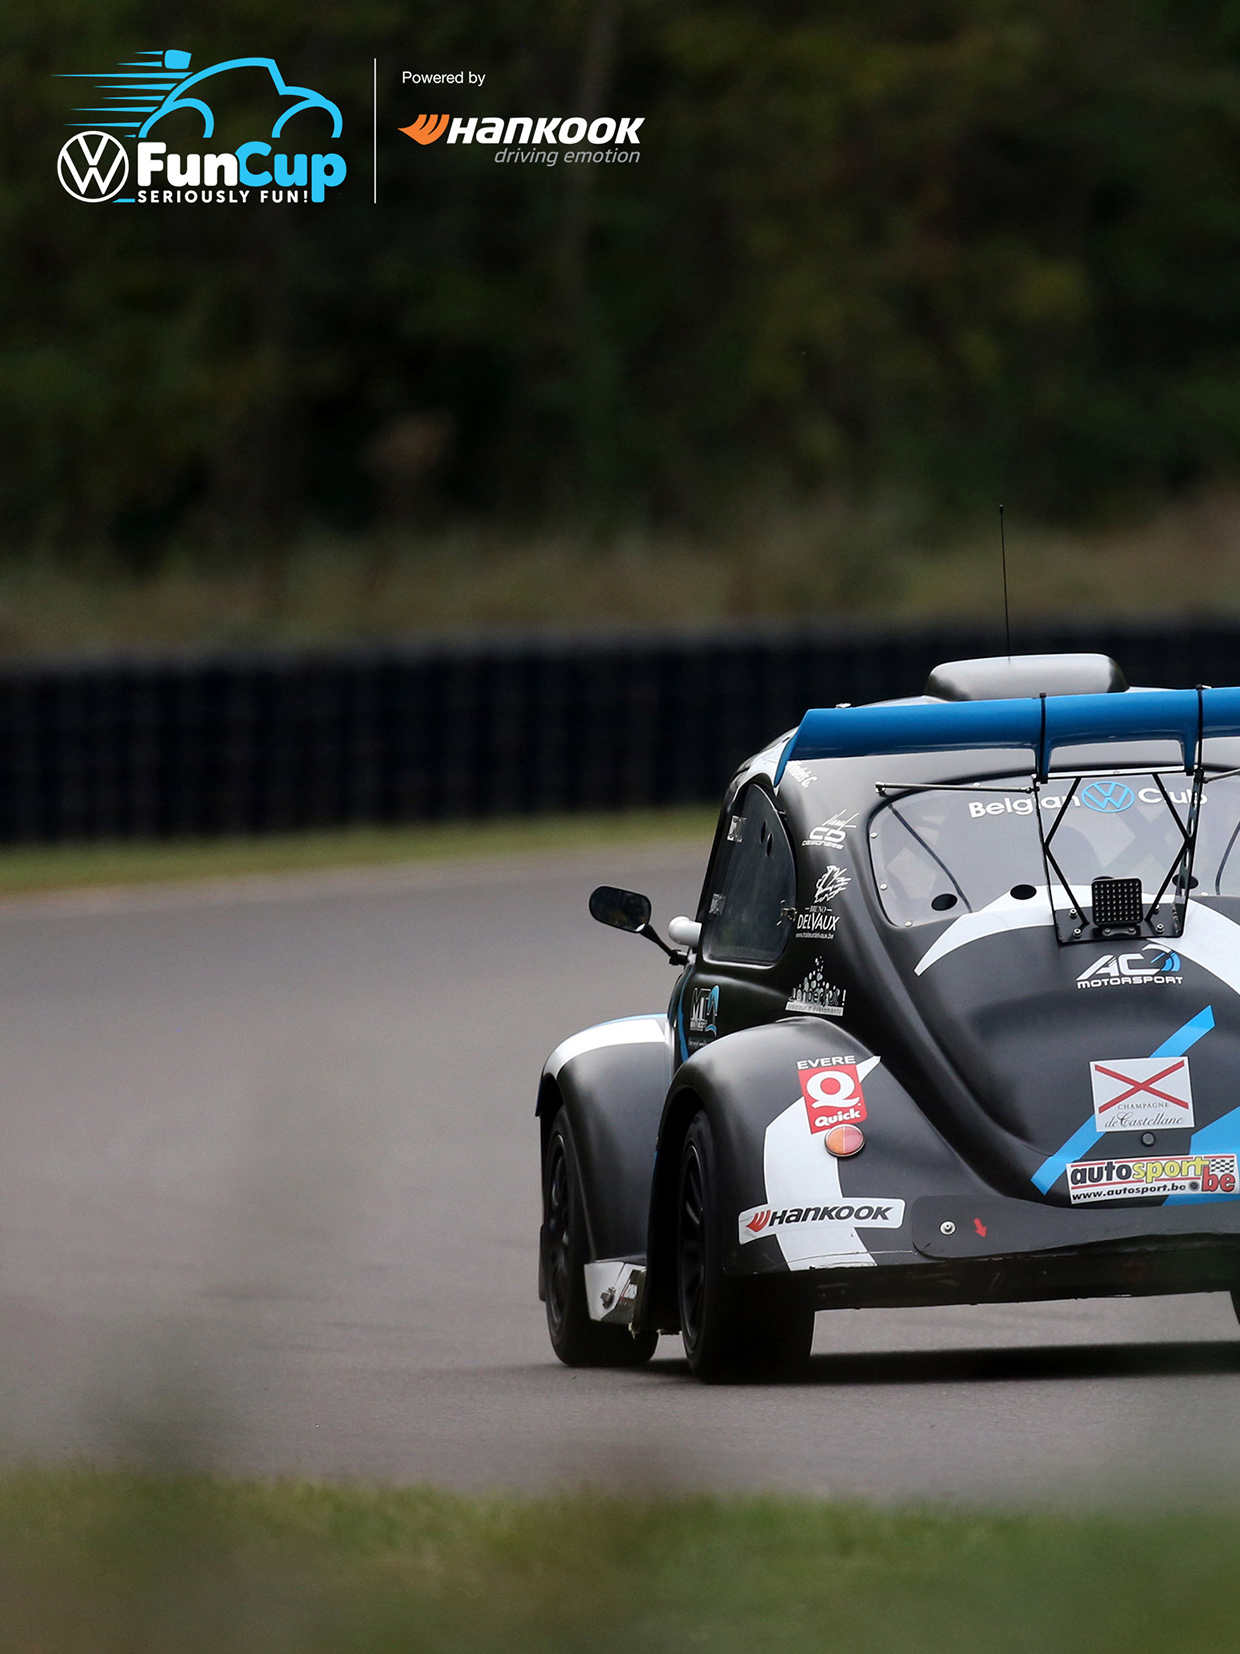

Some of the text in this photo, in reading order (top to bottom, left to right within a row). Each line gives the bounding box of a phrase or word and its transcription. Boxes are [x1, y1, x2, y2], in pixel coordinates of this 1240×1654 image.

[797, 912, 841, 931] DELVAUX
[1075, 953, 1161, 981] AC
[1077, 976, 1184, 990] MOTORSPORT
[796, 1055, 857, 1070] EVERE
[1117, 1102, 1170, 1111] CHAMPAGNE
[814, 1108, 862, 1127] Quick
[1070, 1156, 1210, 1186] autosport
[1072, 1182, 1187, 1201] www.autosport.be
